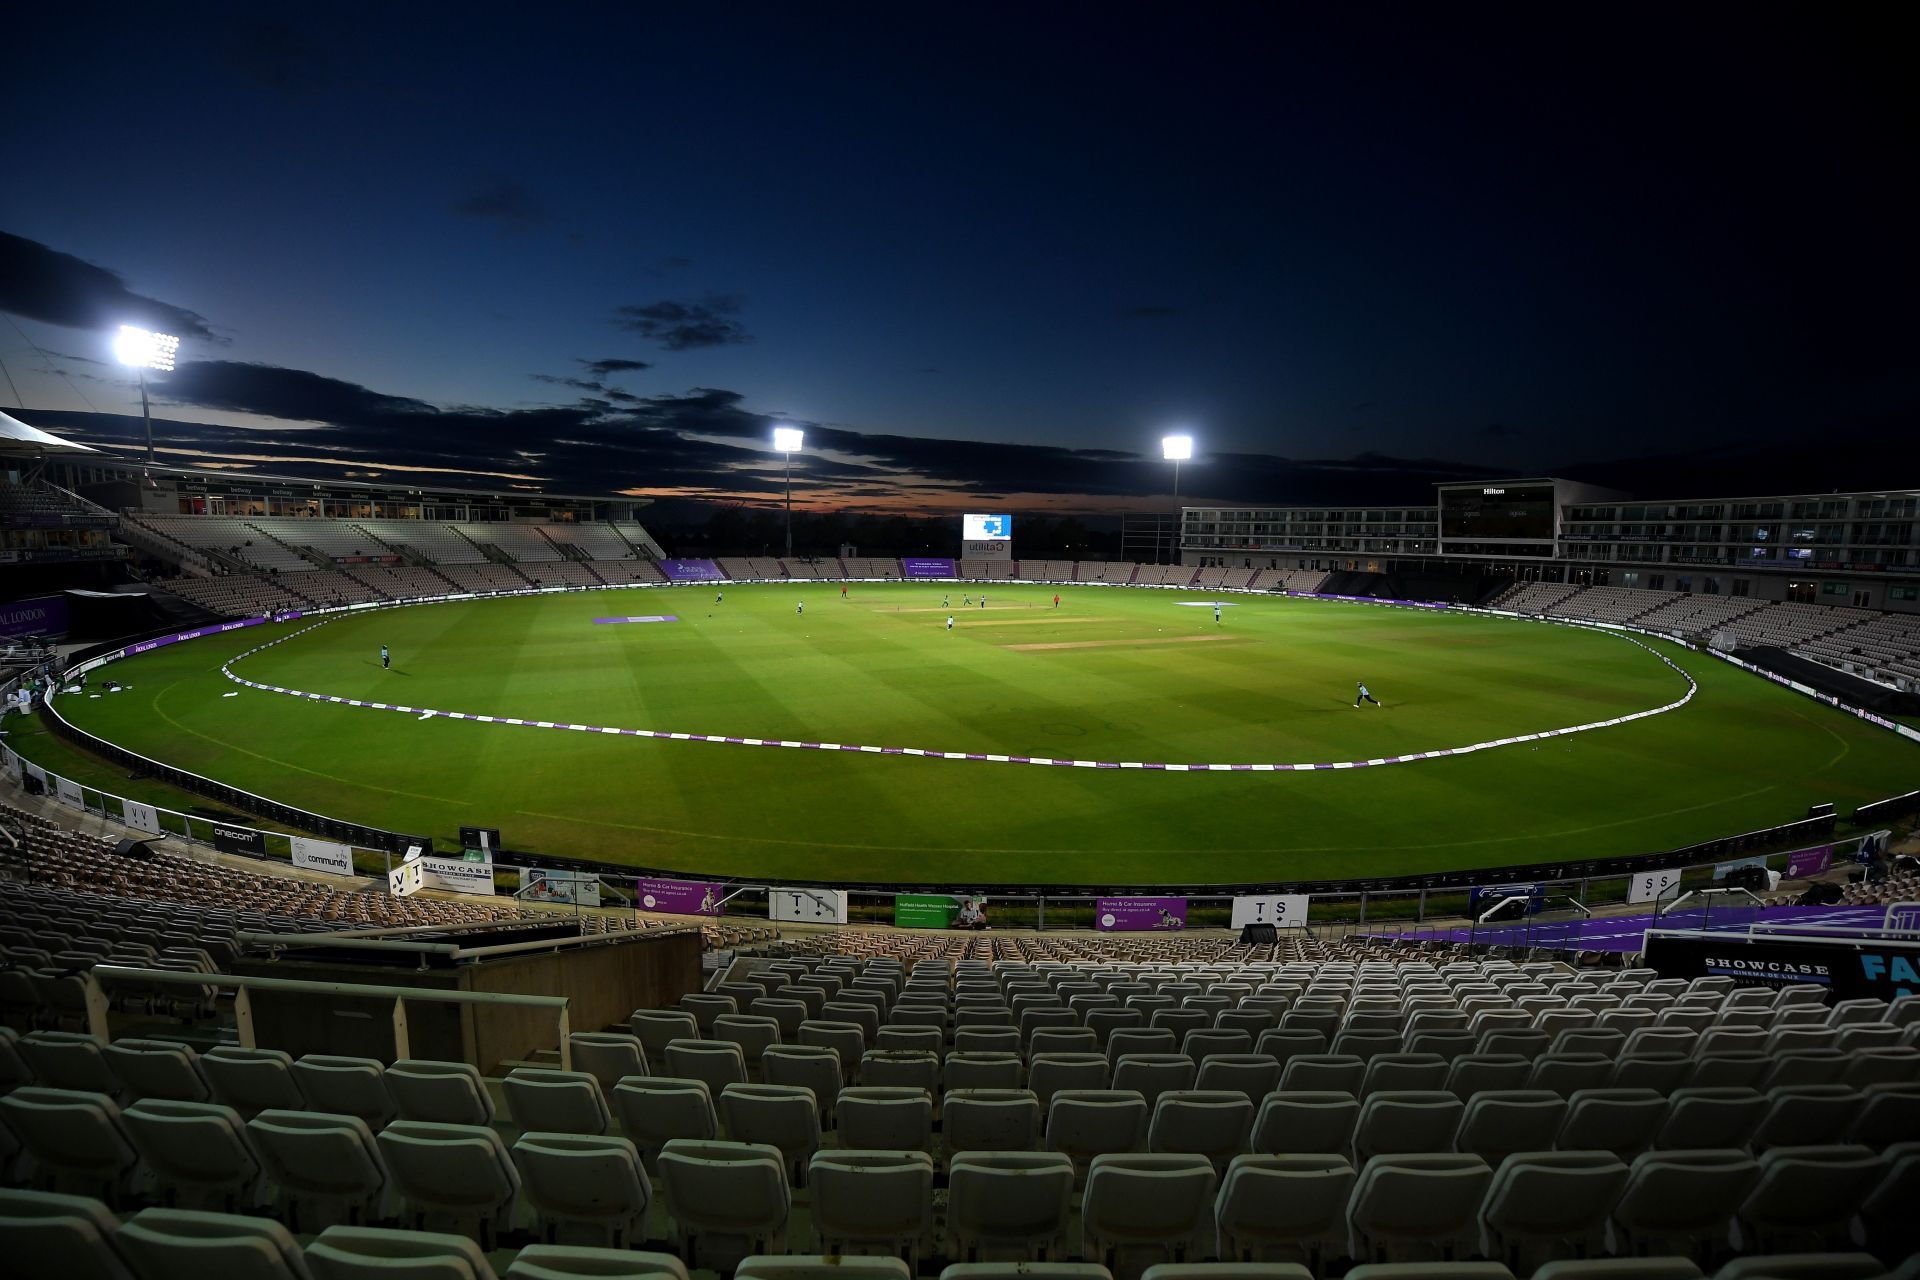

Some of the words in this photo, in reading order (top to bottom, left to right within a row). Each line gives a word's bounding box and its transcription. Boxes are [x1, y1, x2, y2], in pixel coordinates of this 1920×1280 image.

[970, 543, 995, 551] utilita
[11, 608, 46, 624] LONDON
[132, 808, 137, 817] V
[141, 809, 147, 819] V
[215, 828, 253, 842] onecom
[308, 855, 347, 869] community
[423, 862, 492, 875] SHOWCASE
[396, 870, 404, 885] V
[413, 865, 420, 876] T
[1646, 878, 1653, 889] S
[1661, 876, 1668, 887] S
[792, 895, 802, 906] T
[1256, 903, 1265, 914] T
[1276, 902, 1285, 913] S
[1705, 957, 1829, 976] SHOWCASE
[1860, 954, 1920, 983] FA
[1734, 970, 1765, 978] CINEMA
